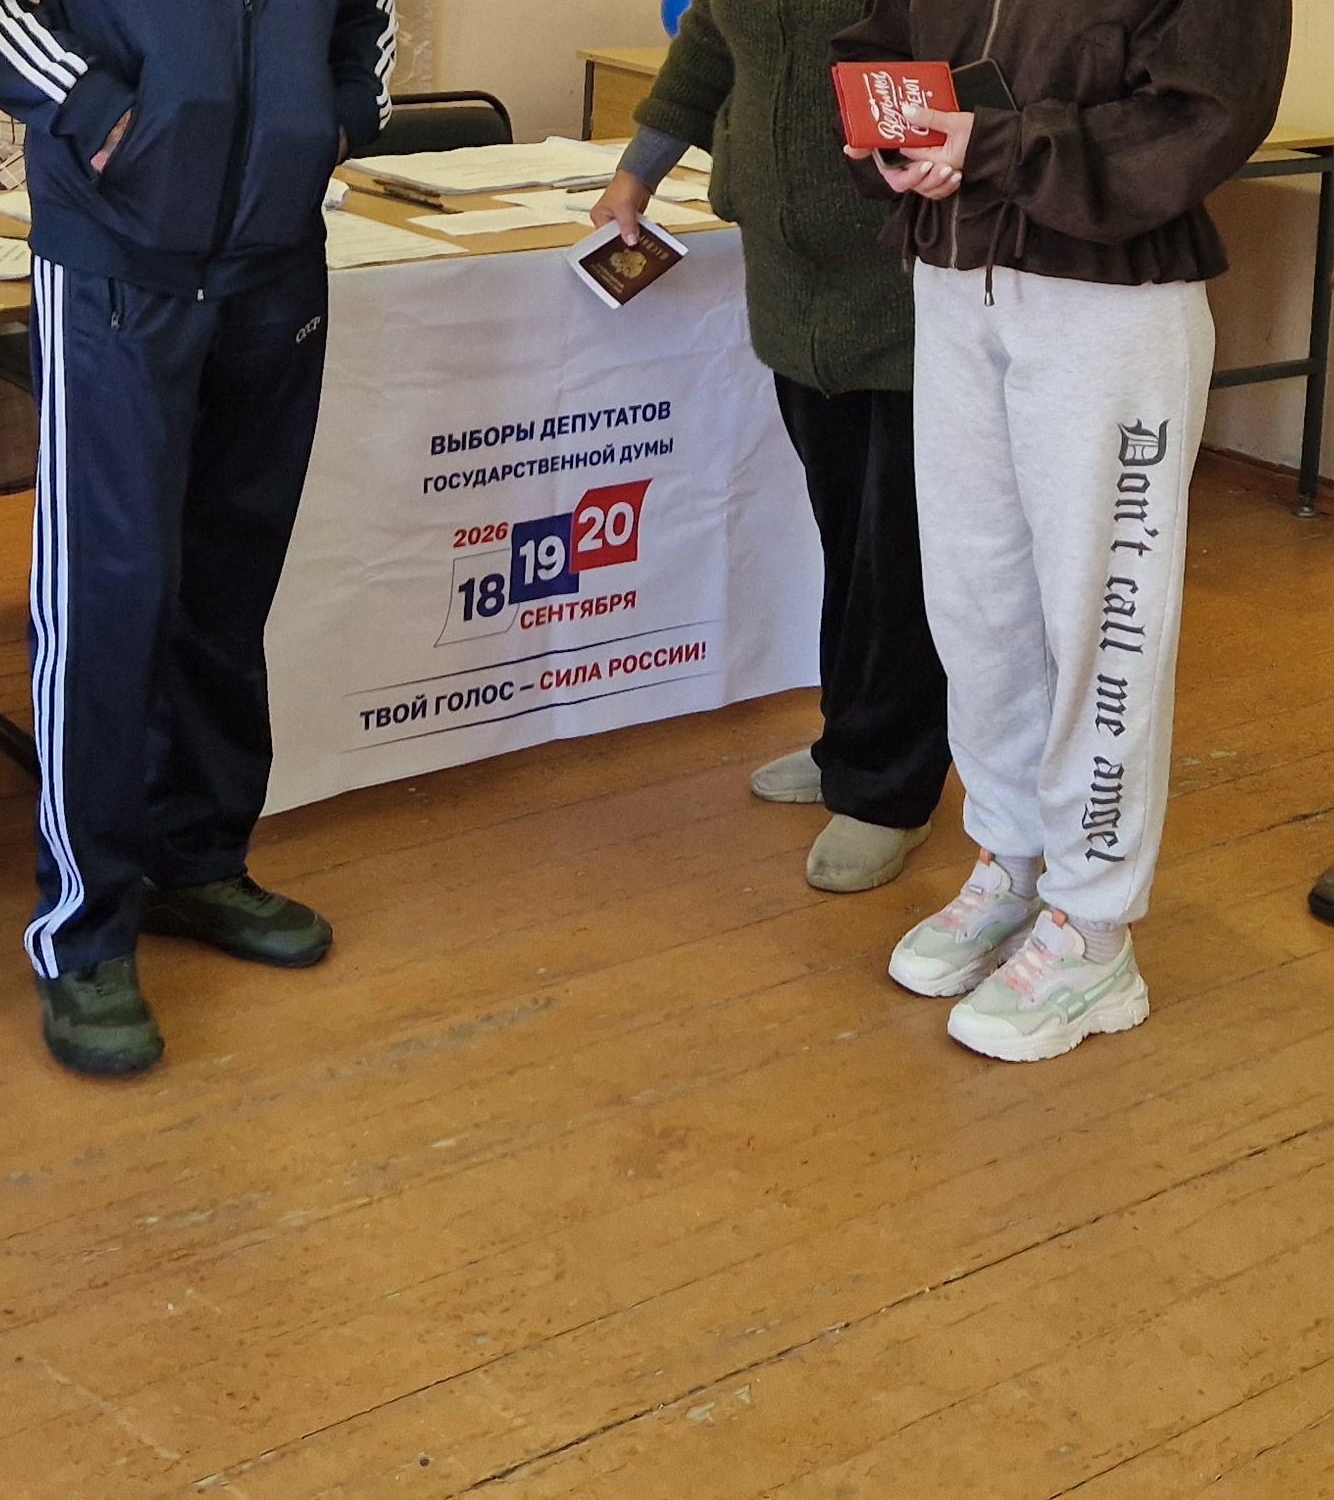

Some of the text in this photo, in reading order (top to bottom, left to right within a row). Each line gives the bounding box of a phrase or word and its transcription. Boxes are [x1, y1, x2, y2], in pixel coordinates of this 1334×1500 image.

[430, 401, 672, 456] ВЫБОРЫ ДЕПУТАТОВ
[423, 437, 674, 494] ГОСУДАРСТВЕННОЙ ДУМЫ
[452, 521, 509, 549] 2026
[457, 501, 635, 623] 18 19 20
[519, 590, 638, 630] СЕНТЯБРЯ
[1081, 417, 1171, 864] Don't call me angel
[359, 695, 427, 732] ТВОЙ
[434, 680, 515, 717] ГОЛОС
[538, 661, 603, 692] СИЛА
[608, 641, 708, 678] РОССИИ!
